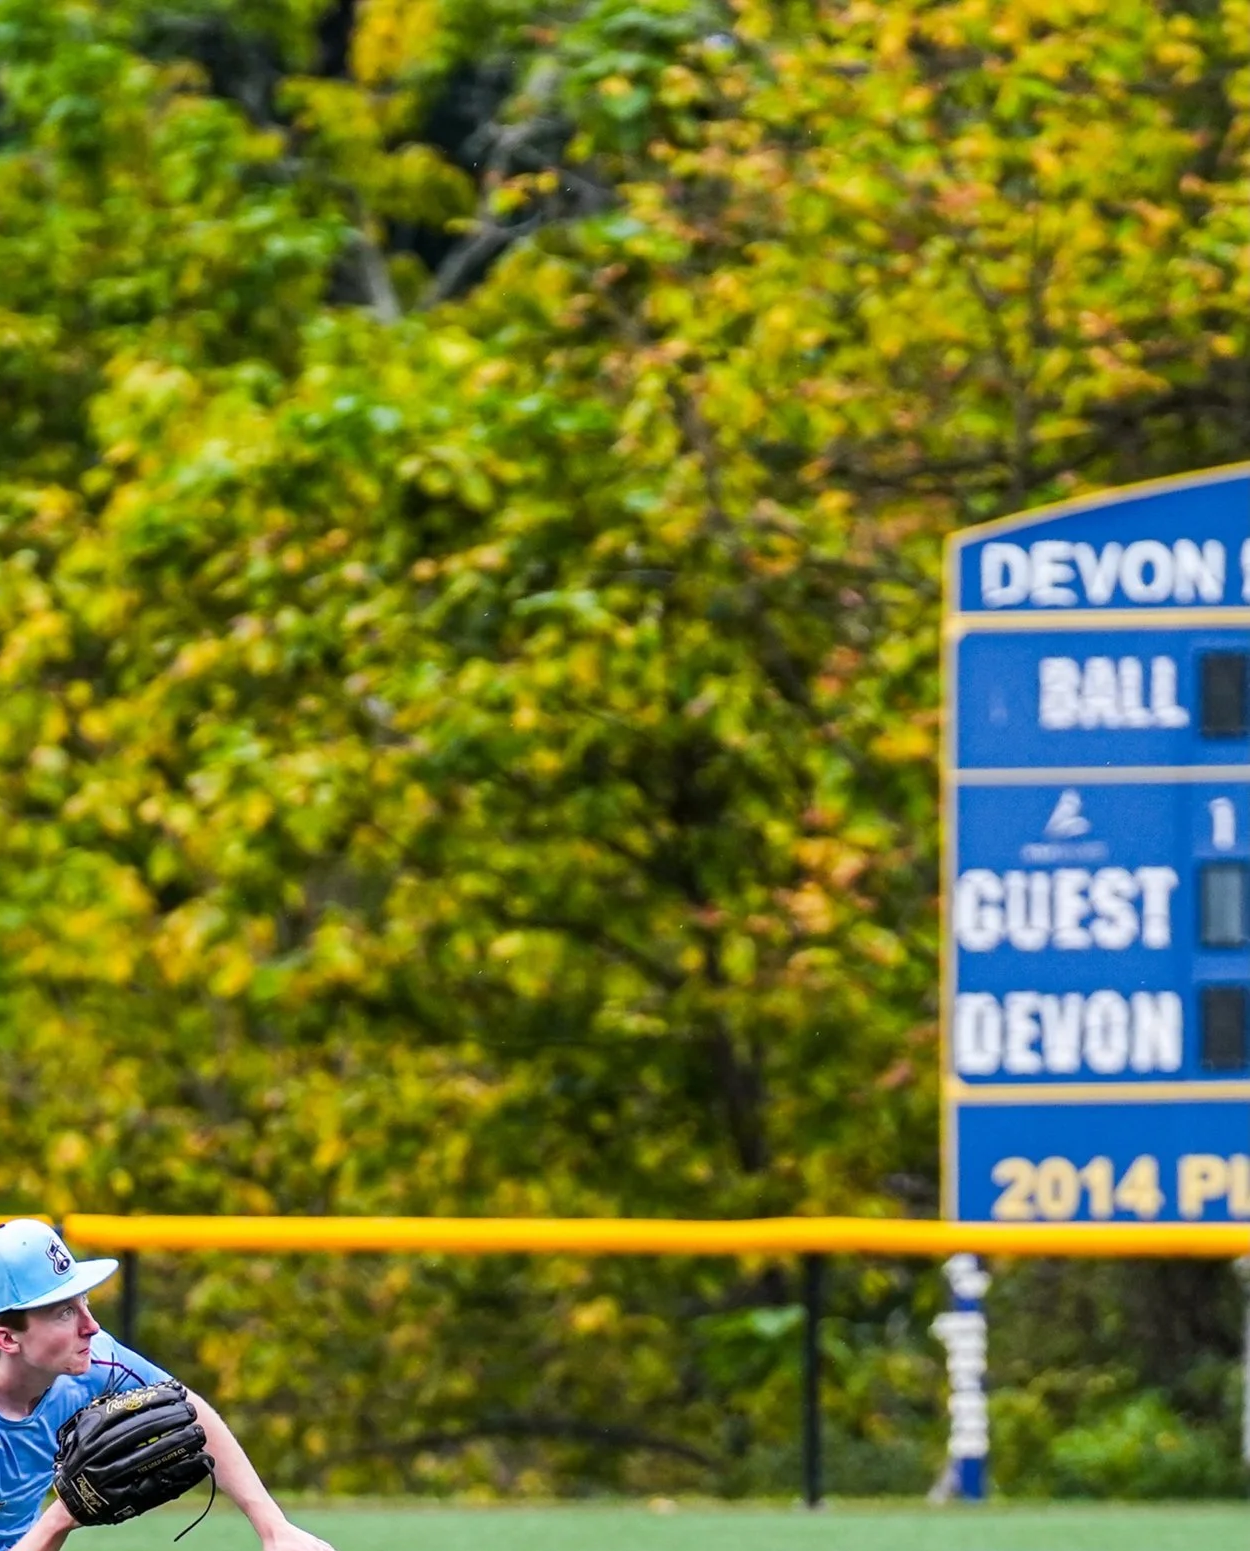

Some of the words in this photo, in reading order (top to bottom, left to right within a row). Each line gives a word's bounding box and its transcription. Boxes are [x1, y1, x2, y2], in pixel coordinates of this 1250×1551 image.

[981, 539, 1227, 606] DEVON
[1039, 656, 1190, 730] BALL
[1209, 797, 1237, 852] 1
[954, 867, 1180, 952] GUEST
[954, 990, 1184, 1076] DEVON
[991, 1154, 1165, 1221] 2014
